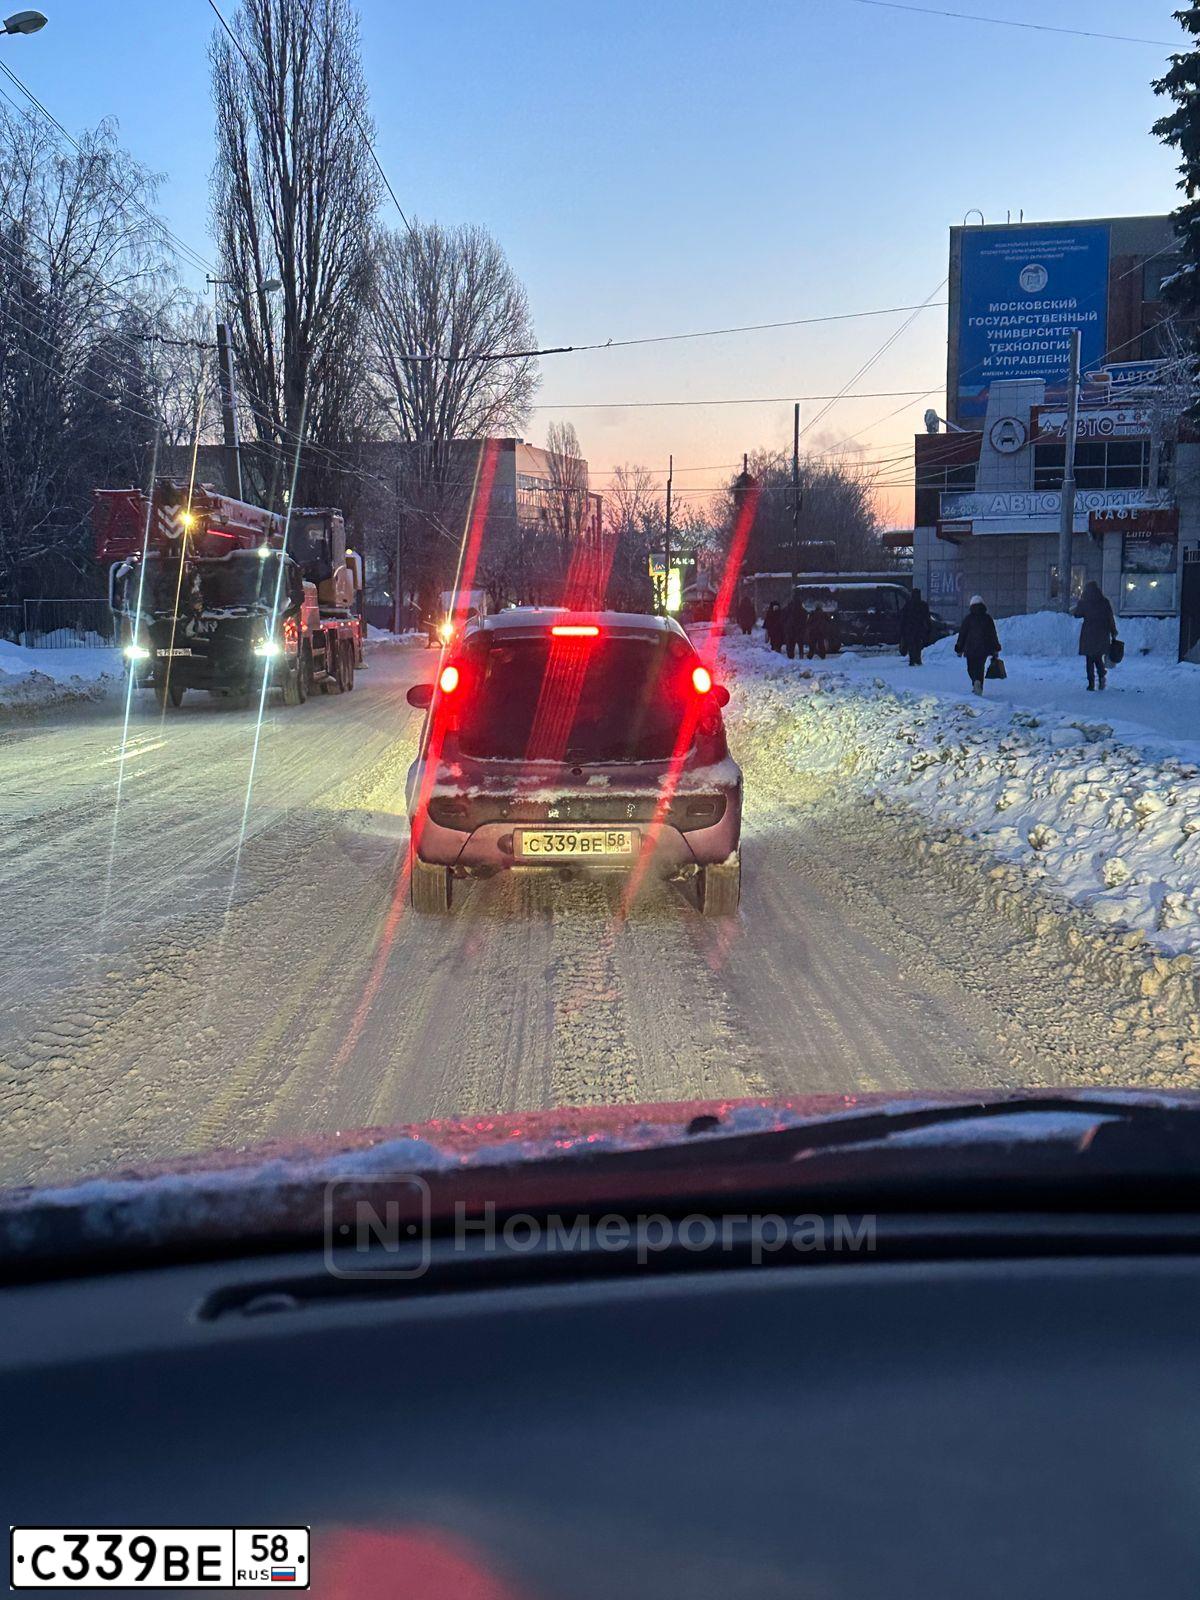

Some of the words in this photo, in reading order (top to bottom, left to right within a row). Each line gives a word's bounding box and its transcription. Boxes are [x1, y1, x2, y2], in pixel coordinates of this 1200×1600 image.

[989, 298, 1077, 312] МОСКОВСКИЙ
[968, 311, 1098, 327] ГОСУДАРСТВЕННЫЙ
[986, 326, 1078, 340] УНИВЕРСИТЕТ
[983, 356, 992, 366] И
[995, 354, 1071, 366] УПРАВЛЕНИ
[1095, 508, 1138, 520] КАФЕ
[529, 835, 602, 852] С339ВЕ
[607, 833, 625, 847] 58
